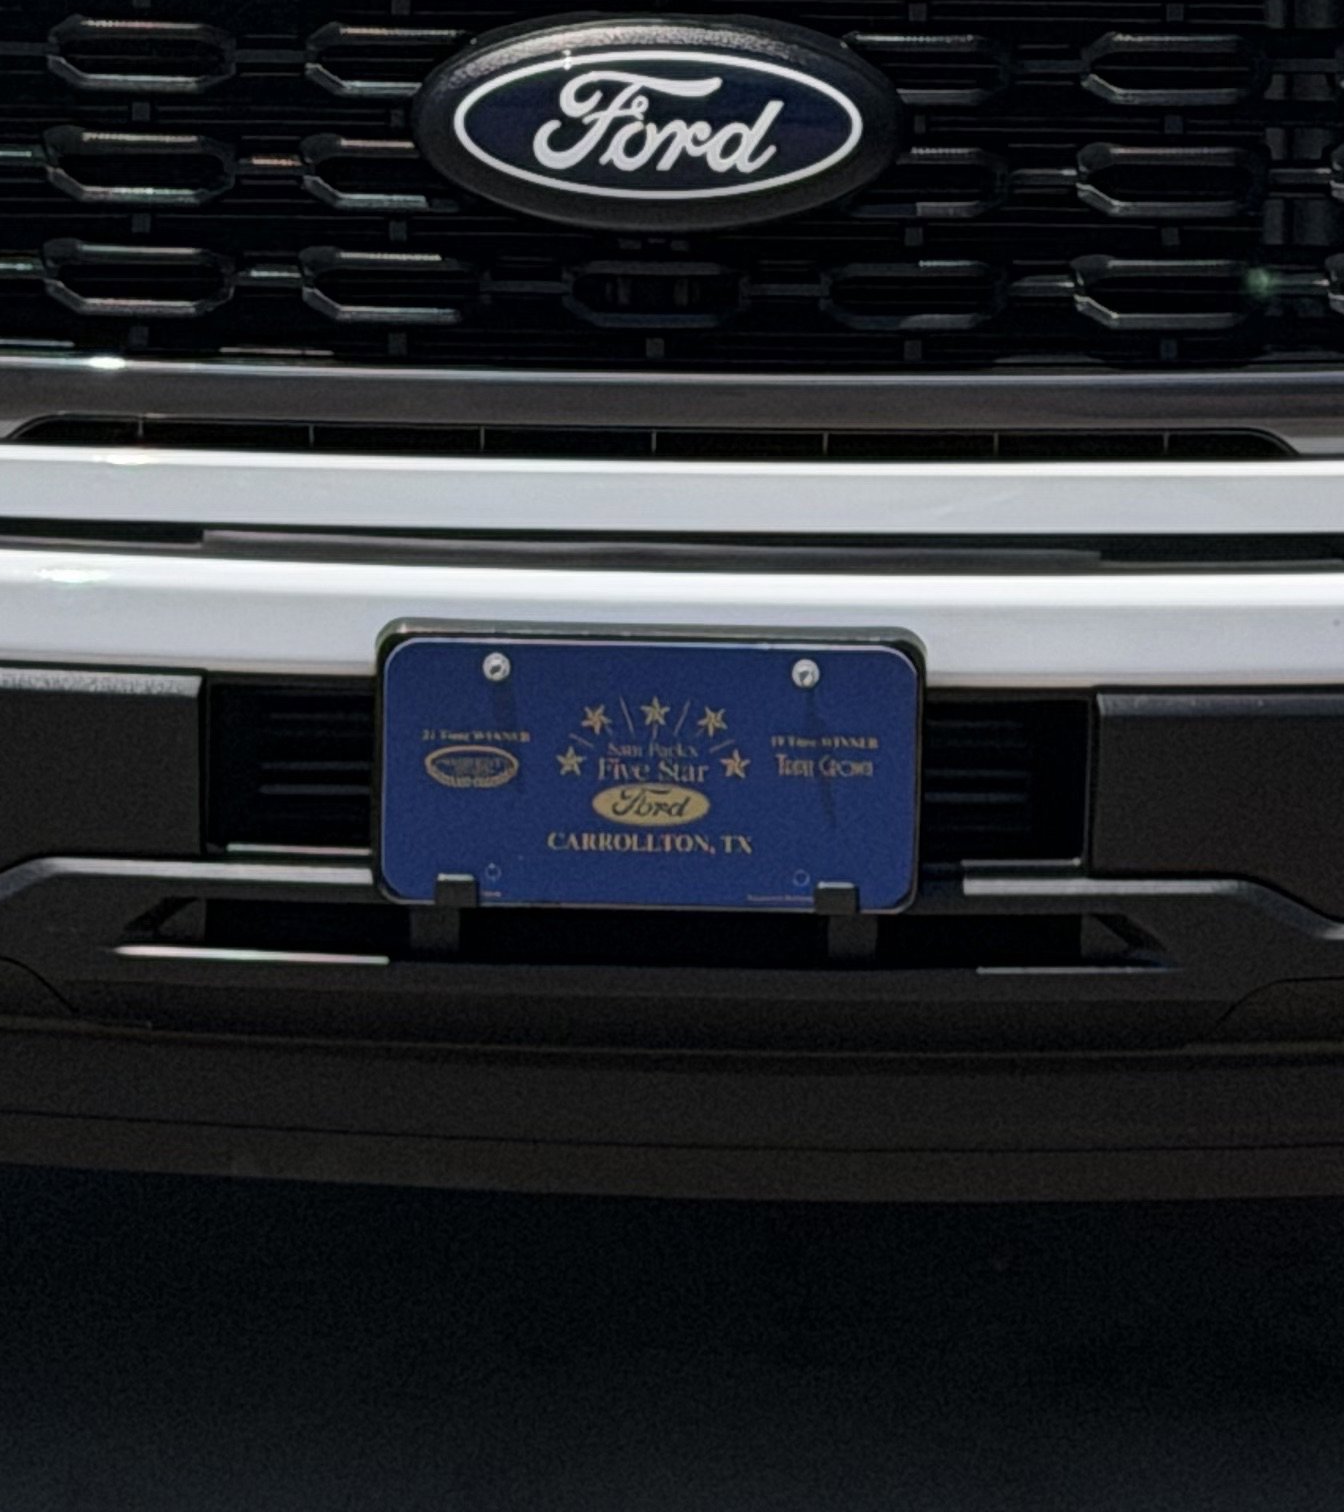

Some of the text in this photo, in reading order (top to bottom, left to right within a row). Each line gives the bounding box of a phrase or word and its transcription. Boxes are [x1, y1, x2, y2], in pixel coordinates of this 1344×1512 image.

[532, 70, 784, 173] Ford
[608, 741, 643, 758] Sam
[598, 755, 710, 783] Five Star
[611, 787, 691, 817] Ford
[546, 831, 753, 855] CARROLLTON, TX
